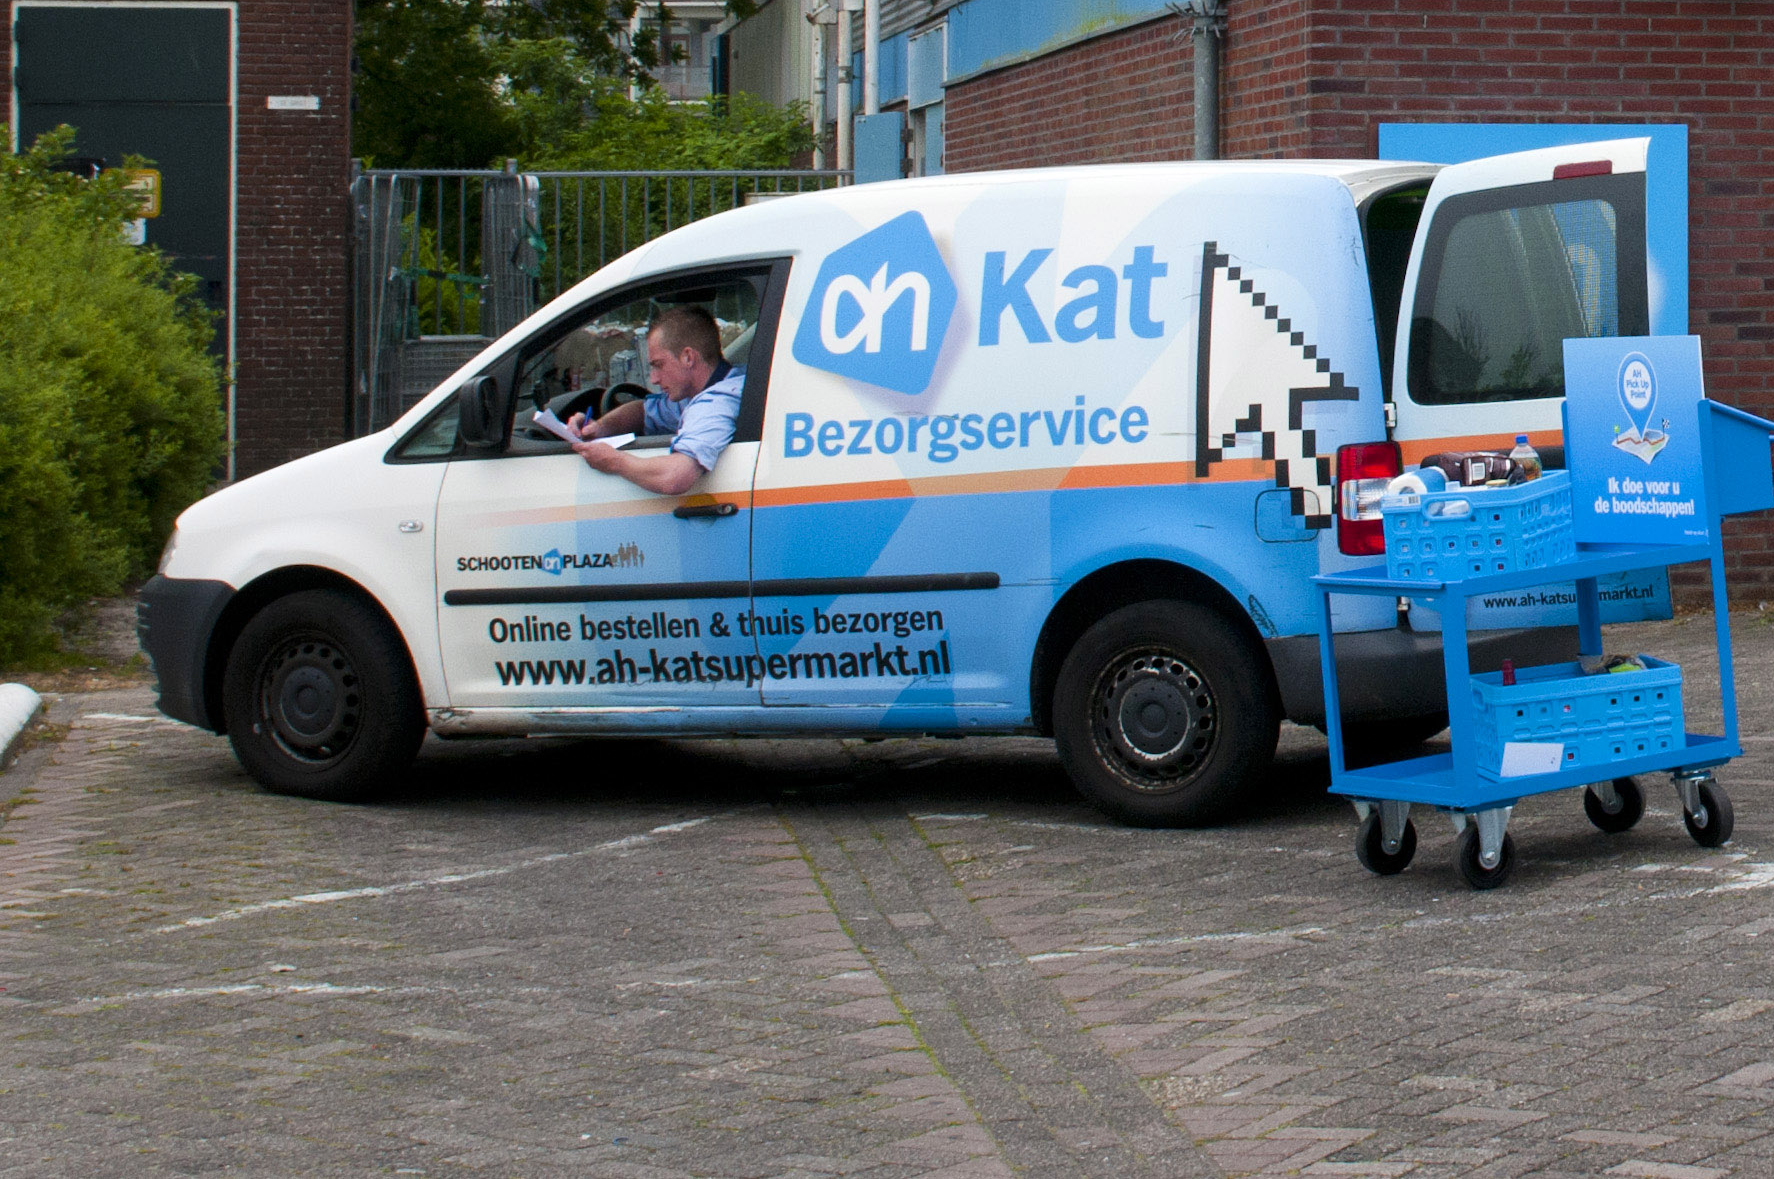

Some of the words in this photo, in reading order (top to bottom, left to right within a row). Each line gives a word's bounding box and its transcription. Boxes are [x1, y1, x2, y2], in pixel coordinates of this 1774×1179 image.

[978, 244, 1169, 347] Kat
[1632, 369, 1642, 378] AH
[783, 394, 1150, 464] Bezorgservice
[1608, 476, 1620, 494] Ik
[1622, 476, 1644, 495] doe
[1646, 481, 1670, 495] voor
[1672, 481, 1681, 495] u
[1594, 496, 1610, 514] de
[1612, 496, 1695, 518] boodschappen!
[457, 555, 543, 571] SCHOOTEN
[562, 553, 613, 569] PLAZA
[1483, 584, 1654, 609] www.ah-katsumarkt.nl
[489, 615, 572, 643] Online
[580, 611, 700, 641] bestellen
[709, 611, 730, 638] &
[737, 608, 805, 637] thuis
[813, 607, 944, 637] bezorgen
[495, 640, 951, 689] www.ah-katsupermarkt.nl
